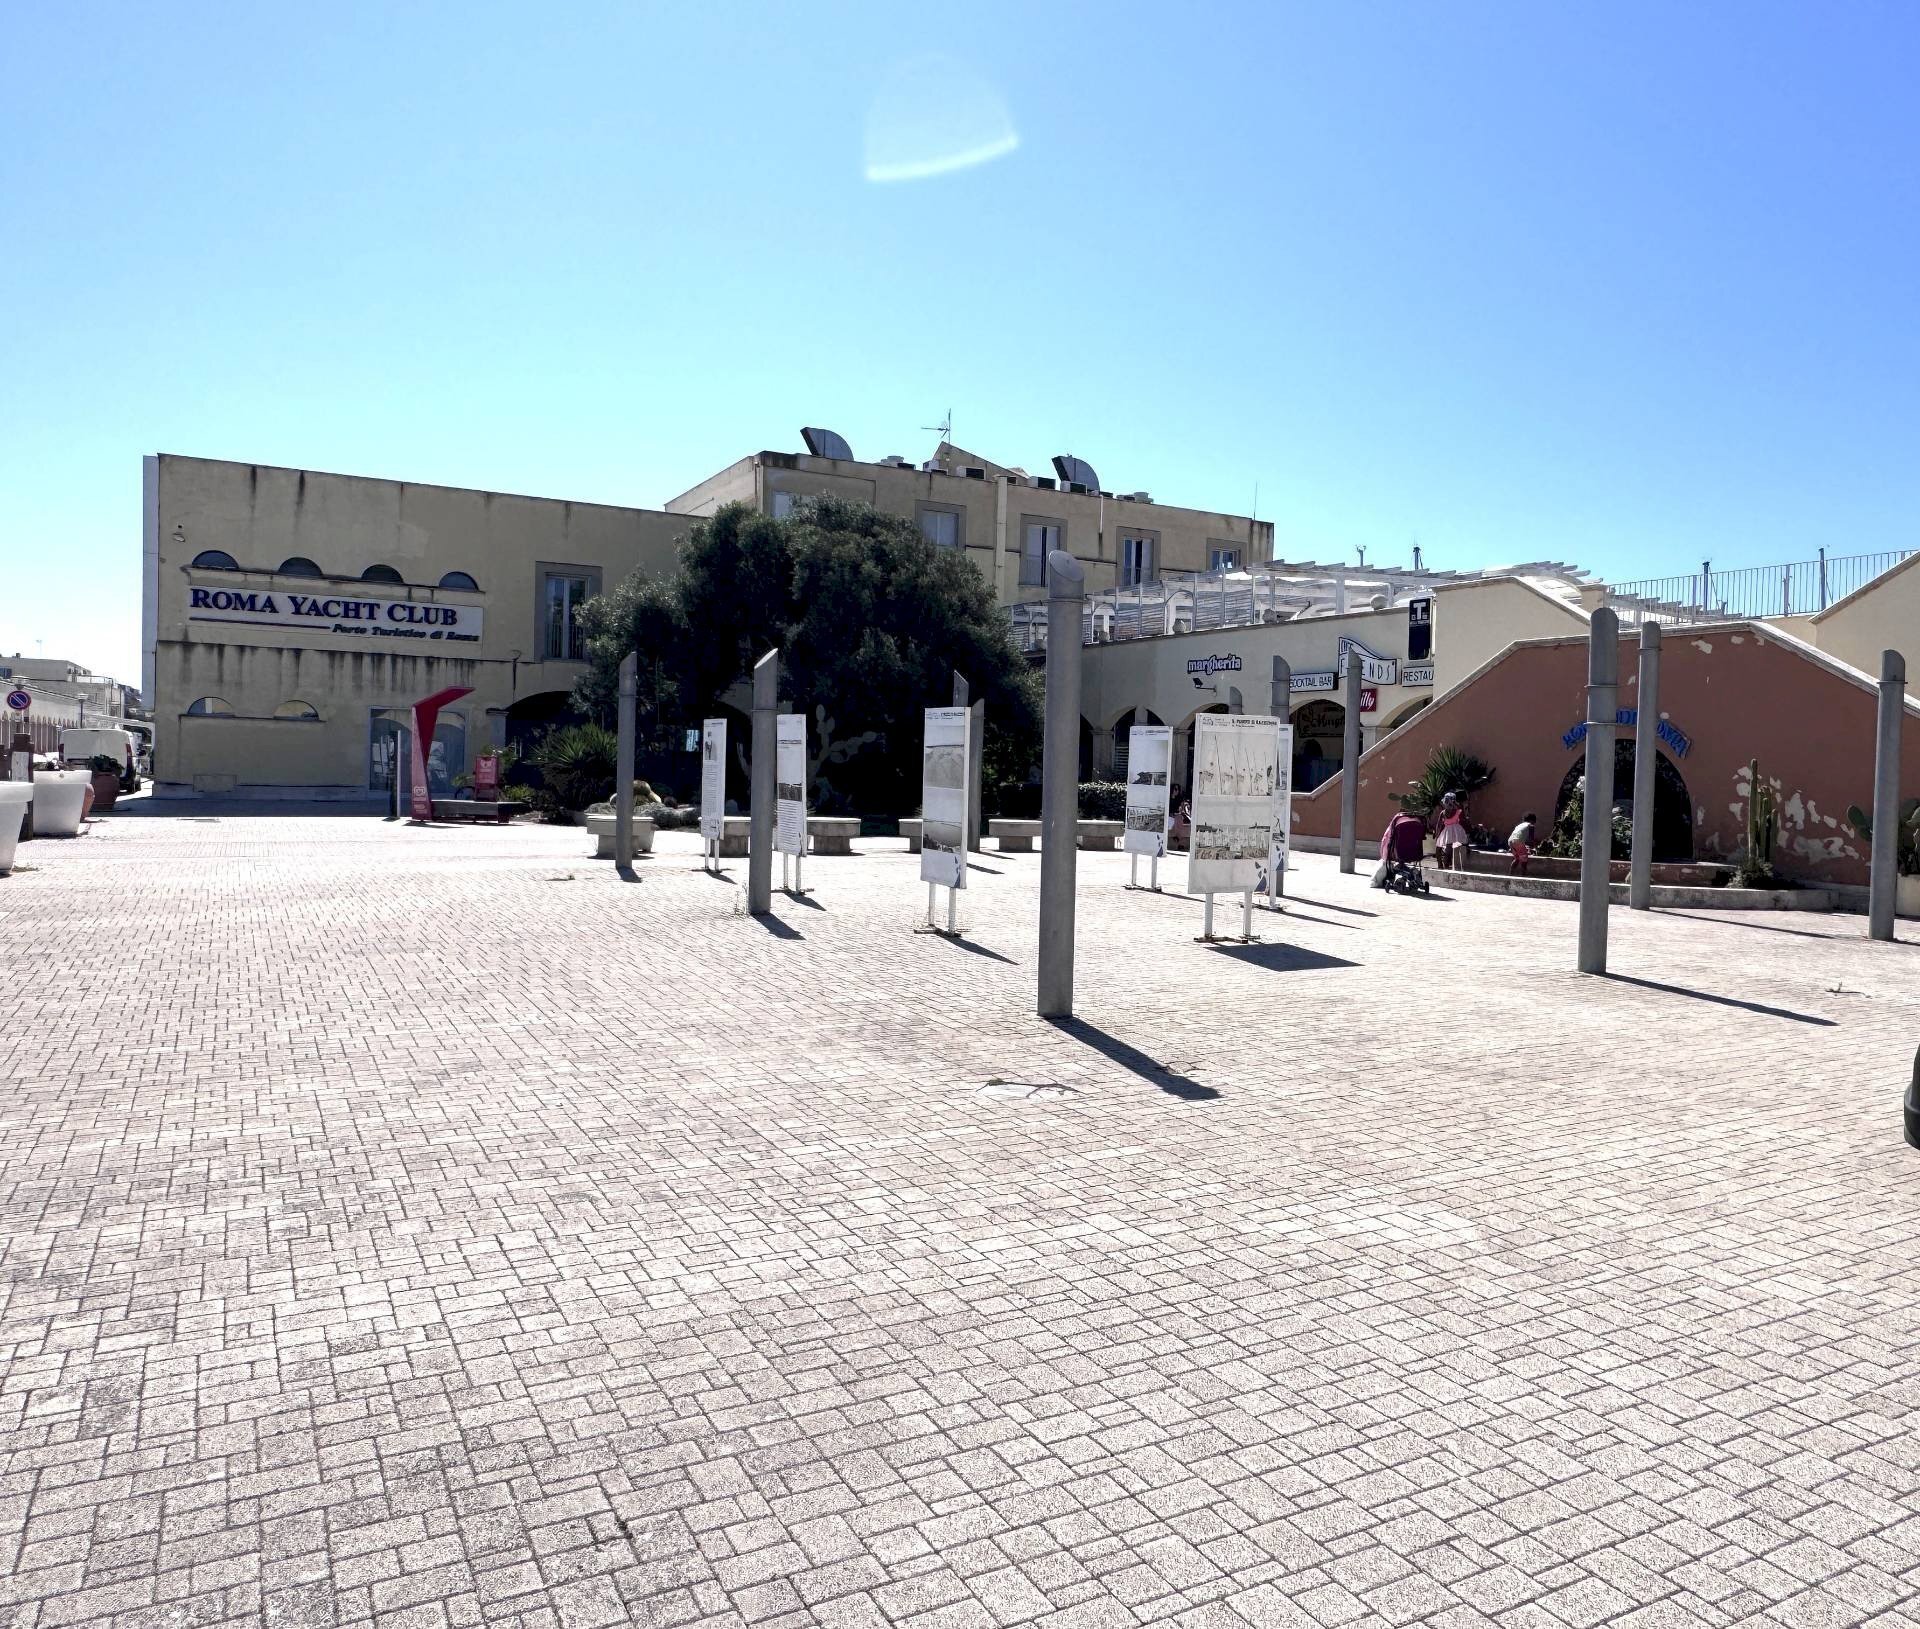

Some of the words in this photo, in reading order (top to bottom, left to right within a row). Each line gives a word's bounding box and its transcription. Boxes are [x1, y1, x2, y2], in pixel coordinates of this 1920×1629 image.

[190, 588, 279, 613] ROMA
[288, 596, 380, 620] YACHT
[387, 603, 458, 626] CLUB
[332, 623, 367, 634] Porto
[372, 626, 427, 639] Turistico
[430, 630, 443, 640] di
[1187, 654, 1242, 675] margherita
[1319, 676, 1332, 687] BAR
[1360, 691, 1375, 710] illy
